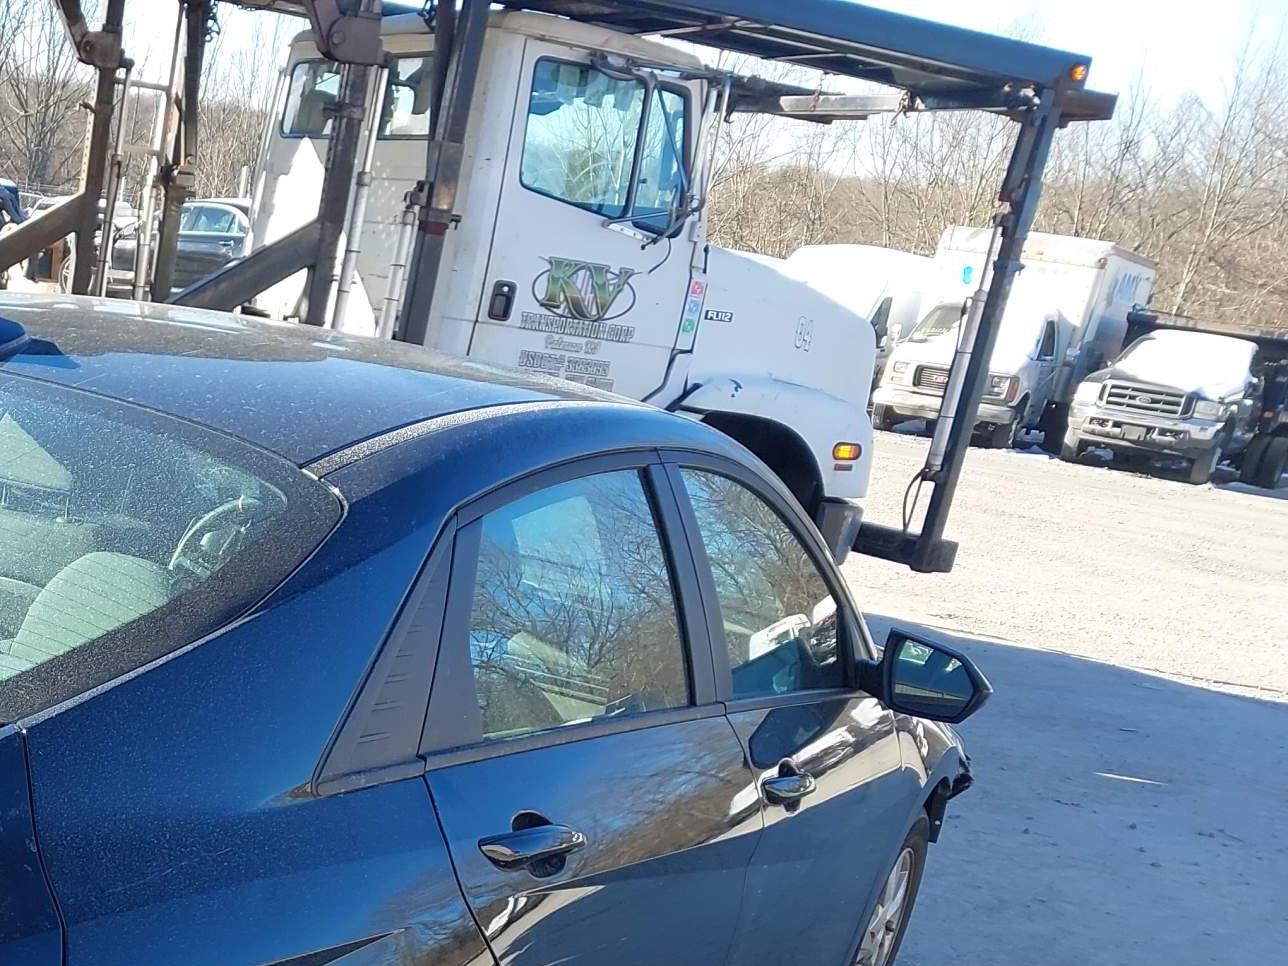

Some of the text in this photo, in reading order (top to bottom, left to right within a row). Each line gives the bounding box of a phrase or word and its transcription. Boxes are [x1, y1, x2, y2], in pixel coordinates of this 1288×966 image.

[539, 256, 634, 322] KV
[520, 311, 636, 343] TRANSPORTATION CORP
